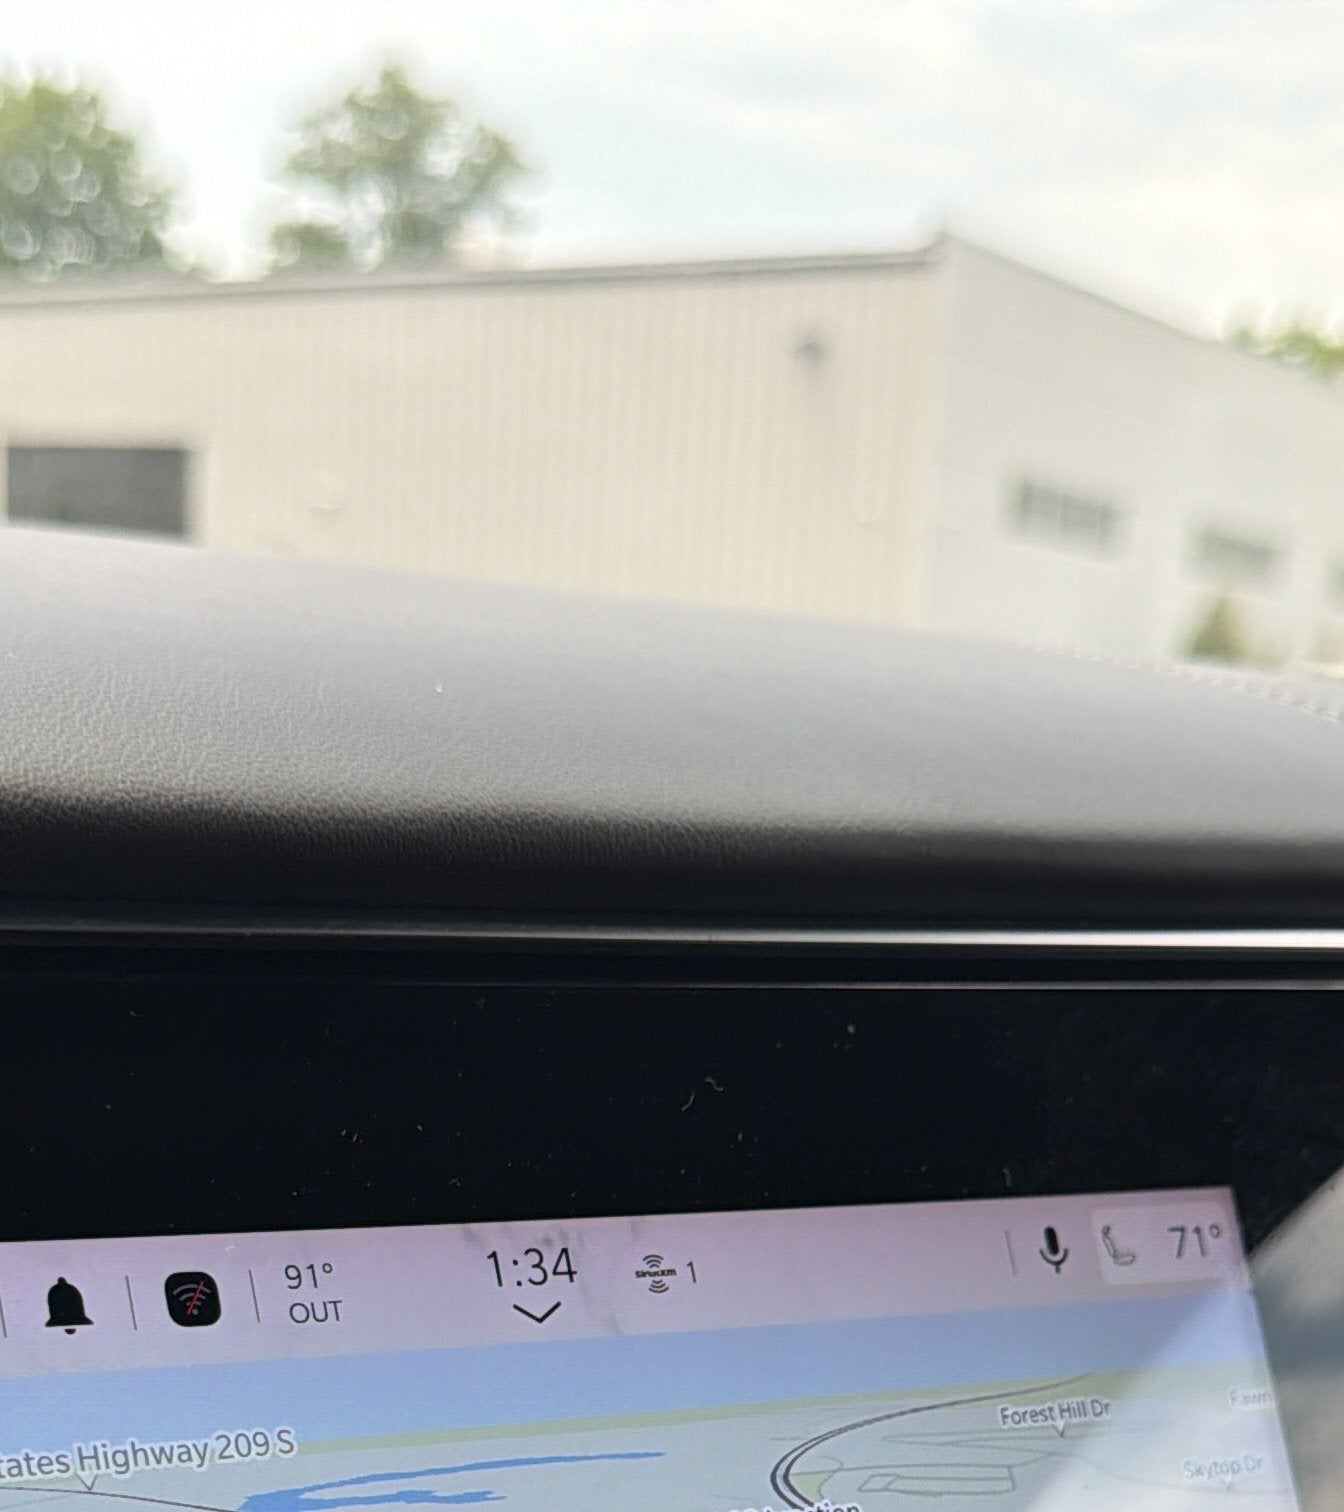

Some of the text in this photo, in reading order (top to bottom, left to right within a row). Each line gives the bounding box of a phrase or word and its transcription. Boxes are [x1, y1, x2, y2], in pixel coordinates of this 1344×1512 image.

[1167, 1225, 1222, 1259] 71°
[284, 1263, 333, 1290] 91°
[487, 1247, 577, 1287] 1:34
[686, 1261, 697, 1283] 1
[289, 1300, 343, 1324] OUT
[1001, 1400, 1111, 1426] Forest Hill Dr
[78, 1440, 208, 1475] Highway
[216, 1432, 269, 1460] 209
[278, 1430, 294, 1455] S
